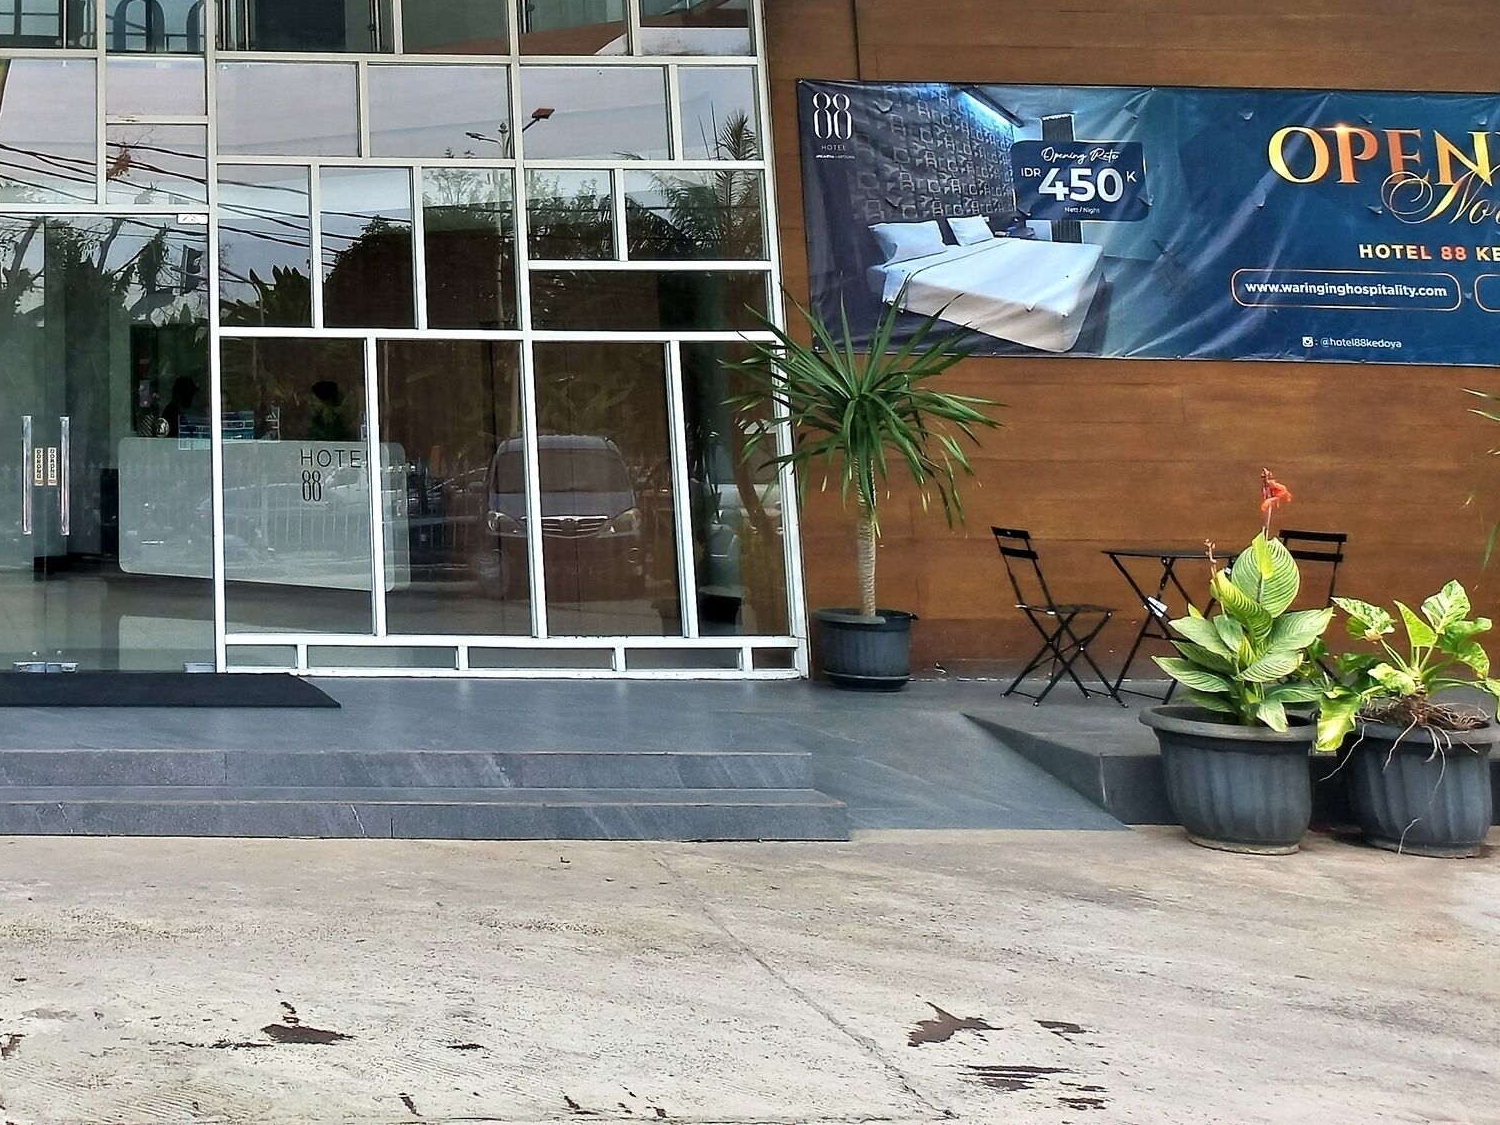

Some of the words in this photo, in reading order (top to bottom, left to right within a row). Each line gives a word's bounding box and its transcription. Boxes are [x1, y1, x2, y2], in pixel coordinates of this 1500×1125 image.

[812, 92, 852, 140] 88
[821, 144, 846, 152] HOTEL
[1040, 146, 1088, 165] Opening
[1089, 147, 1121, 163] Rate
[1267, 124, 1500, 187] OPEN
[1020, 167, 1042, 178] IDR
[1038, 167, 1124, 203] 450
[1126, 170, 1138, 183] K
[1380, 165, 1500, 225] No
[1064, 206, 1079, 214] Nett
[1083, 206, 1101, 215] Night
[1358, 243, 1432, 261] HOTEL
[1440, 245, 1468, 262] 88
[1244, 281, 1448, 298] www.waringinghospitality.com
[1320, 336, 1403, 349] @hotel88kedoya
[301, 469, 322, 502] 88
